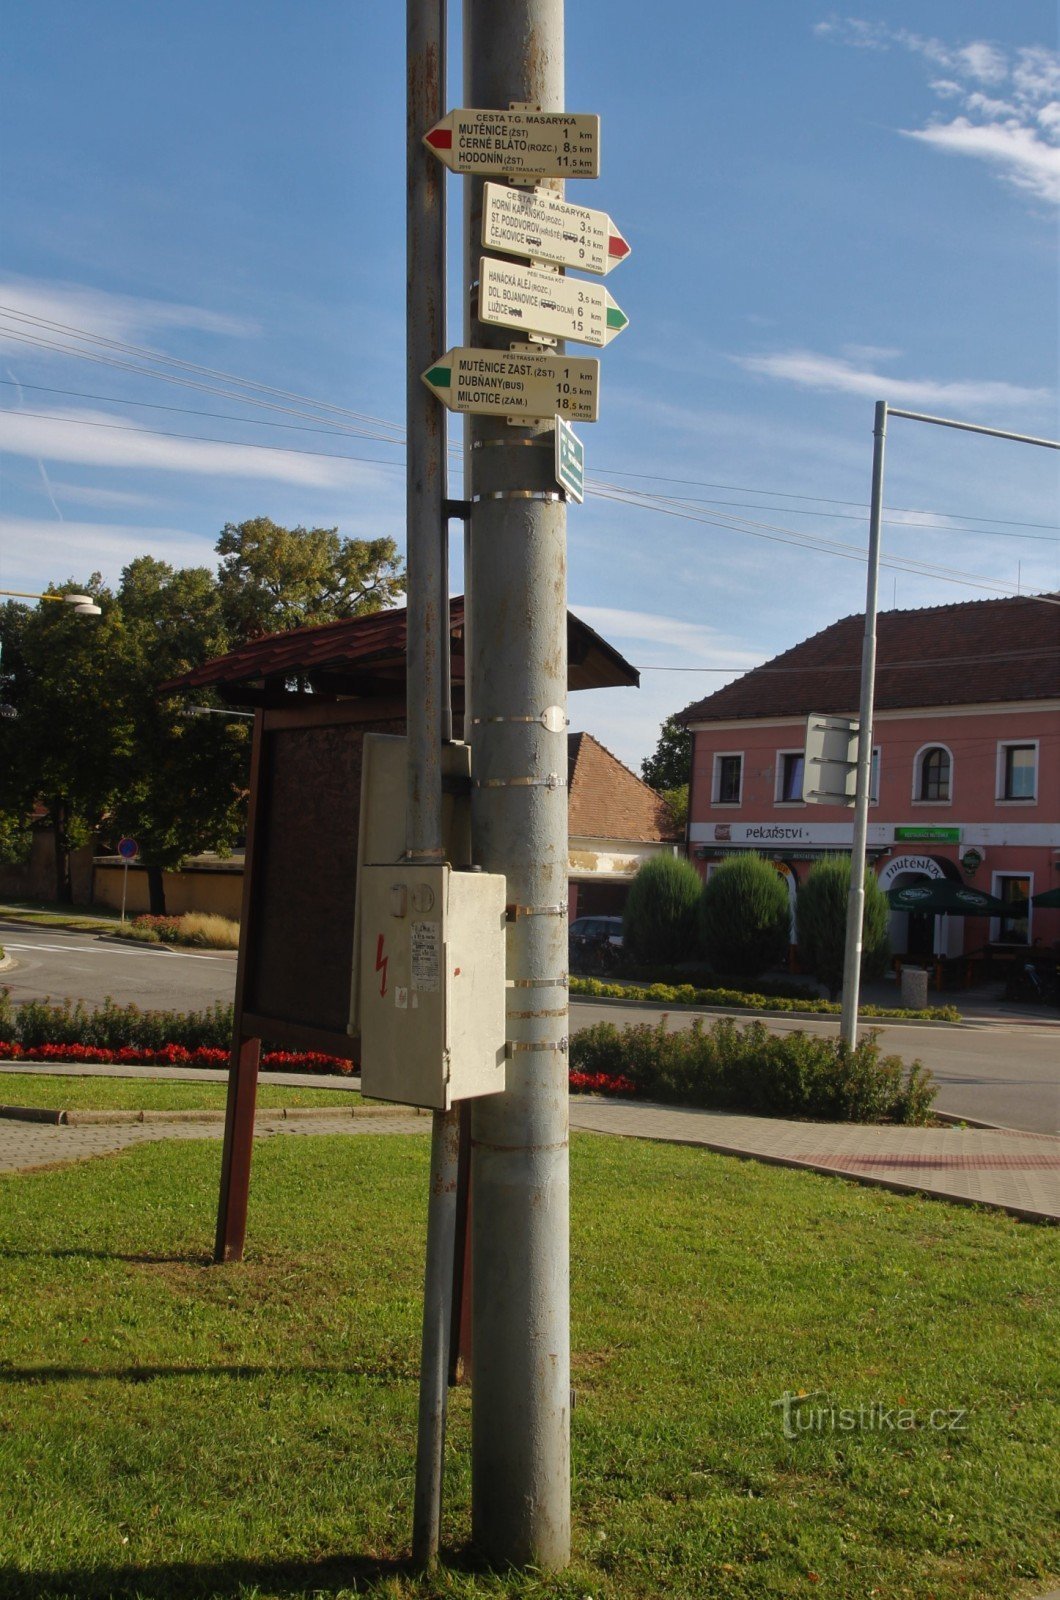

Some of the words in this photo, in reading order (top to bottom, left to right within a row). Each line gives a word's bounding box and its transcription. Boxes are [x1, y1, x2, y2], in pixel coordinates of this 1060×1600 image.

[526, 117, 576, 125] MASARYKA
[459, 122, 507, 136] MUTĚNICE
[563, 129, 568, 138] 1
[460, 136, 492, 149] ČERNÉ
[495, 137, 527, 150] BLÁTO
[459, 151, 502, 164] HODONÍN
[492, 198, 511, 211] HORNÍ
[512, 202, 544, 220] KAPÁNSKO
[507, 192, 534, 204] CESTA
[534, 199, 547, 208] T.G.
[549, 203, 590, 220] MASARYKA
[492, 213, 500, 223] ST.
[502, 217, 539, 234] PODDVOROV
[491, 225, 524, 244] ČEJKOVICE
[579, 249, 584, 258] 9
[540, 251, 555, 259] TRASA
[489, 271, 516, 286] HANÁCKÁ
[518, 277, 530, 288] ALEJ
[489, 286, 501, 298] DOL.
[503, 289, 538, 306] BOJANOVICE
[578, 307, 583, 316] 6
[488, 300, 508, 314] LUŽICE
[572, 320, 583, 331] 15
[460, 359, 505, 373] MUTĚNICE
[508, 364, 532, 376] ZAST.
[564, 369, 568, 378] 1
[459, 375, 502, 389] DUBŇANY
[458, 391, 500, 404] MILOTICE
